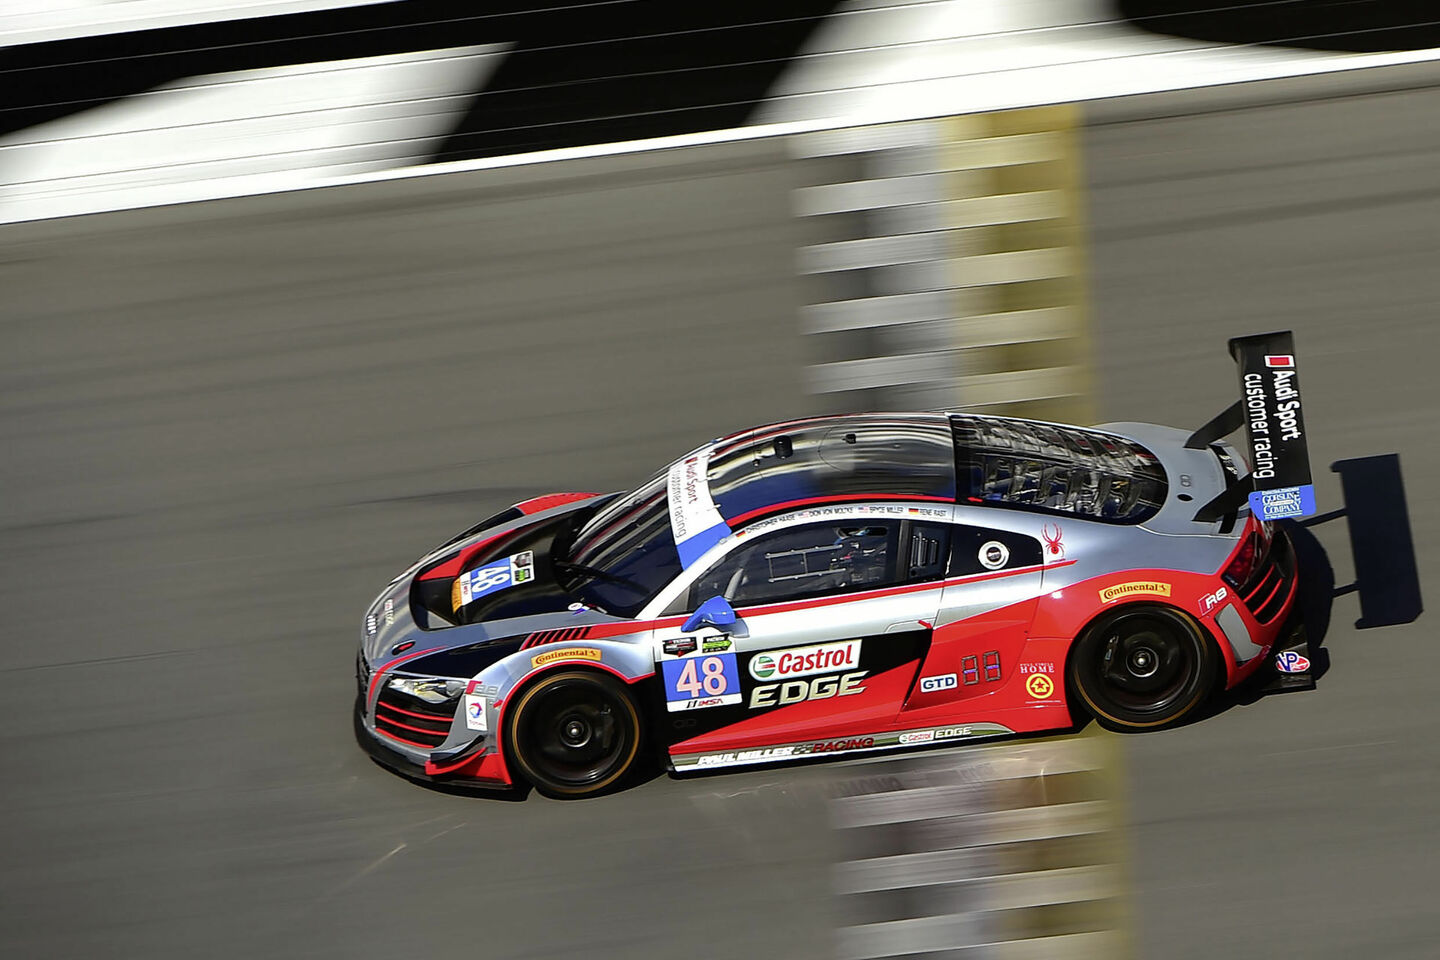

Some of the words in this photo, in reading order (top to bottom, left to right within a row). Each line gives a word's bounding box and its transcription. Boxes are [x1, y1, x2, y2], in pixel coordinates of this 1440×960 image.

[1271, 370, 1299, 400] Audi
[1244, 373, 1270, 433] customer
[1273, 400, 1301, 441] Sport
[1252, 438, 1279, 479] racing
[684, 478, 698, 504] Sport
[1263, 501, 1301, 515] COMPANY
[674, 506, 687, 538] racing
[471, 566, 511, 593] 48
[1103, 584, 1159, 599] Continental
[1205, 586, 1228, 609] R8
[535, 649, 588, 665] Continental
[778, 643, 853, 675] Castrol
[1020, 665, 1055, 674] HOME
[676, 656, 728, 698] 48
[748, 670, 870, 709] EDGE
[922, 676, 956, 690] GTD
[811, 737, 875, 753] RACING
[907, 733, 932, 742] Castrol
[934, 726, 972, 739] EDGE
